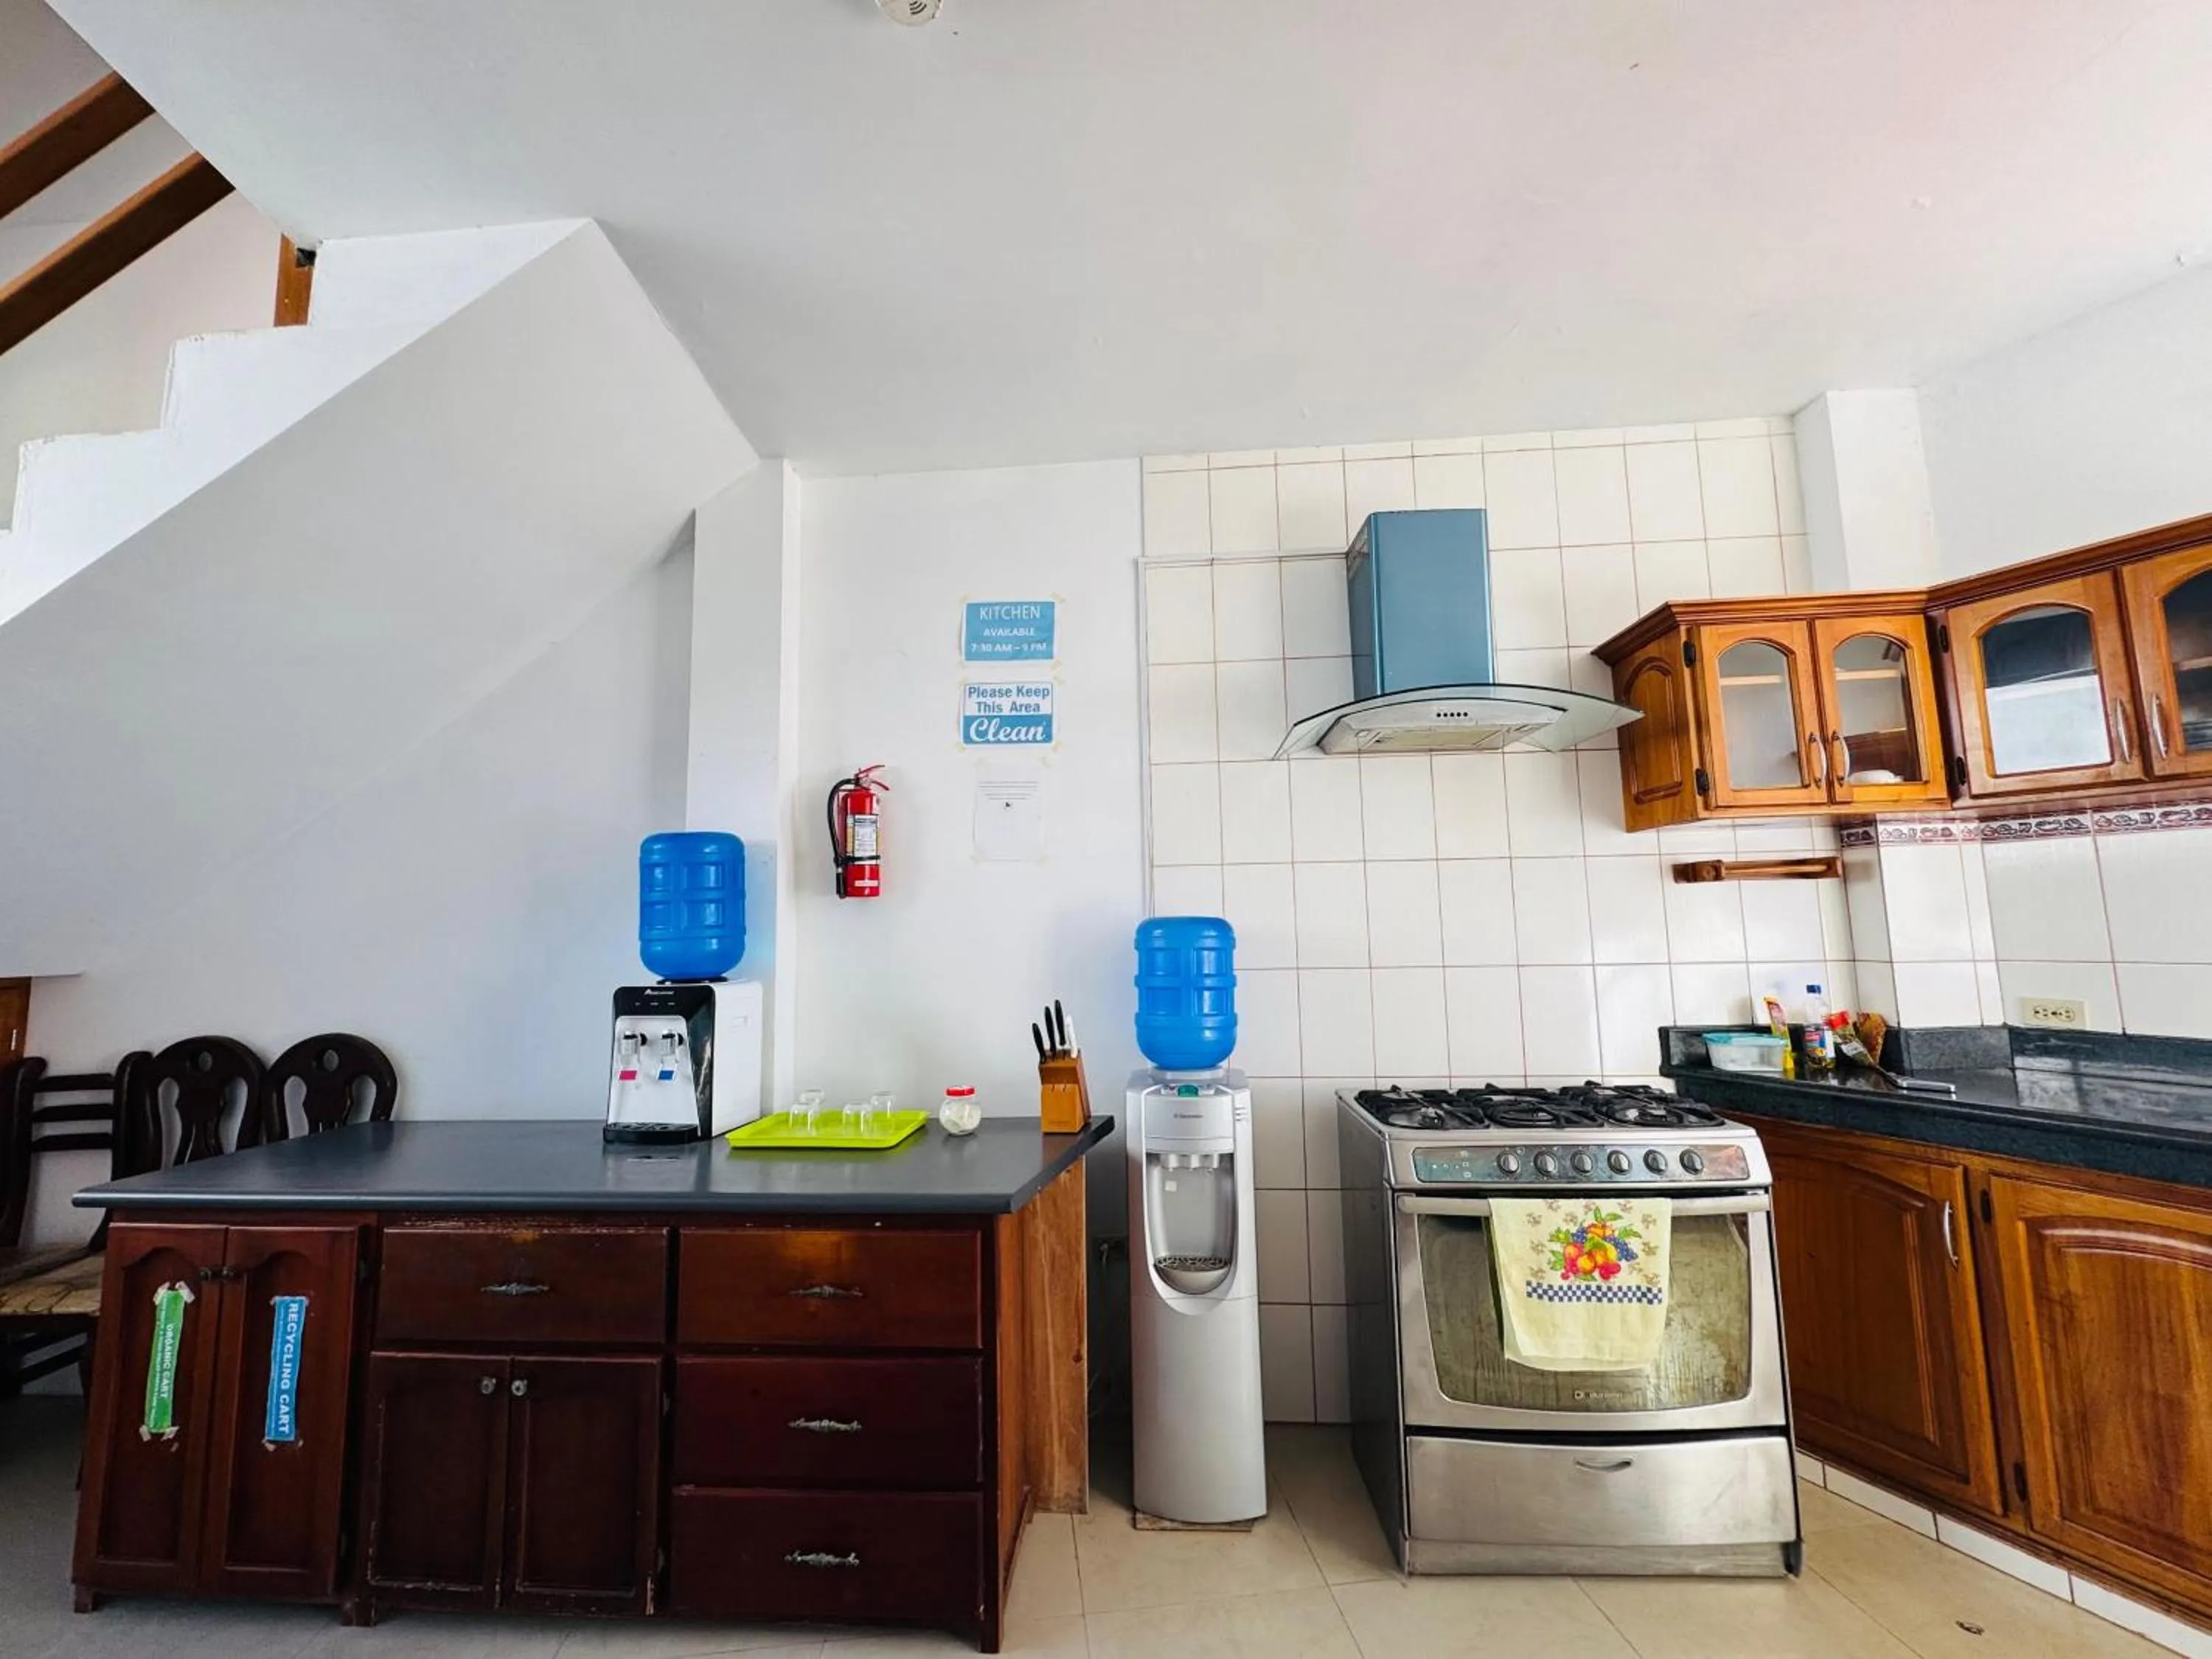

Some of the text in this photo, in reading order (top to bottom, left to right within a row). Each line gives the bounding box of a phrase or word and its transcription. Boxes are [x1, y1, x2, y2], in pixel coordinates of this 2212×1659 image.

[979, 605, 1040, 620] KITCHEN
[983, 627, 1036, 636] AVAILABLE
[971, 643, 992, 653] 7:30
[994, 643, 1012, 652] AM
[1022, 643, 1028, 652] 9
[1030, 642, 1047, 652] PM
[968, 685, 1050, 700] Please Keep
[975, 701, 1040, 714] This Area
[970, 717, 1046, 742] Clean
[160, 1324, 174, 1399] ORGANIC CART
[278, 1303, 299, 1434] RECYCLING CART
